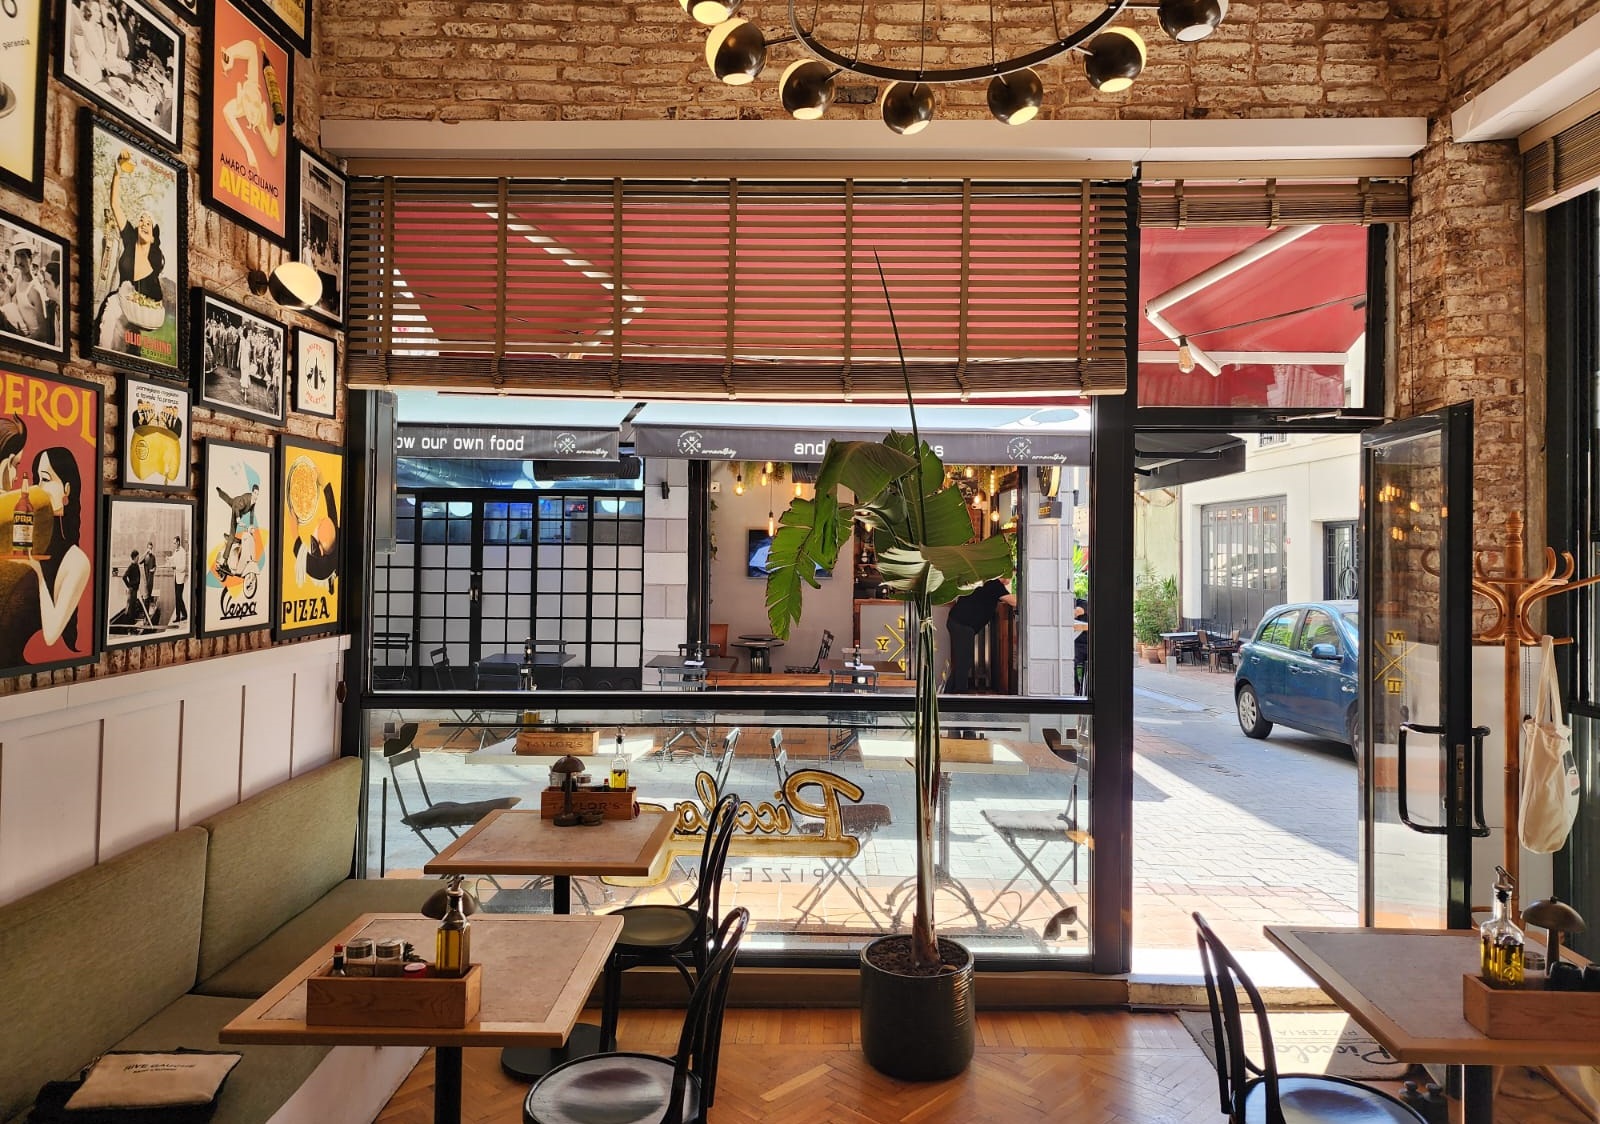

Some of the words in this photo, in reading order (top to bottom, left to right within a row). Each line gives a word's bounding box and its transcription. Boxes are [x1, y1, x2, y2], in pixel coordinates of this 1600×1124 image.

[220, 152, 246, 177] AMARO
[247, 169, 279, 198] SICILIANO
[219, 165, 280, 222] AVERNA
[0, 373, 97, 448] EROL
[421, 437, 447, 450] our
[453, 437, 484, 450] own
[489, 434, 525, 451] food
[794, 440, 826, 455] and
[219, 586, 258, 621] Vespa
[282, 596, 331, 624] PIZZA
[875, 636, 891, 653] Y
[526, 740, 584, 749] TAYLOR'S
[552, 802, 621, 810] TYLOR'S
